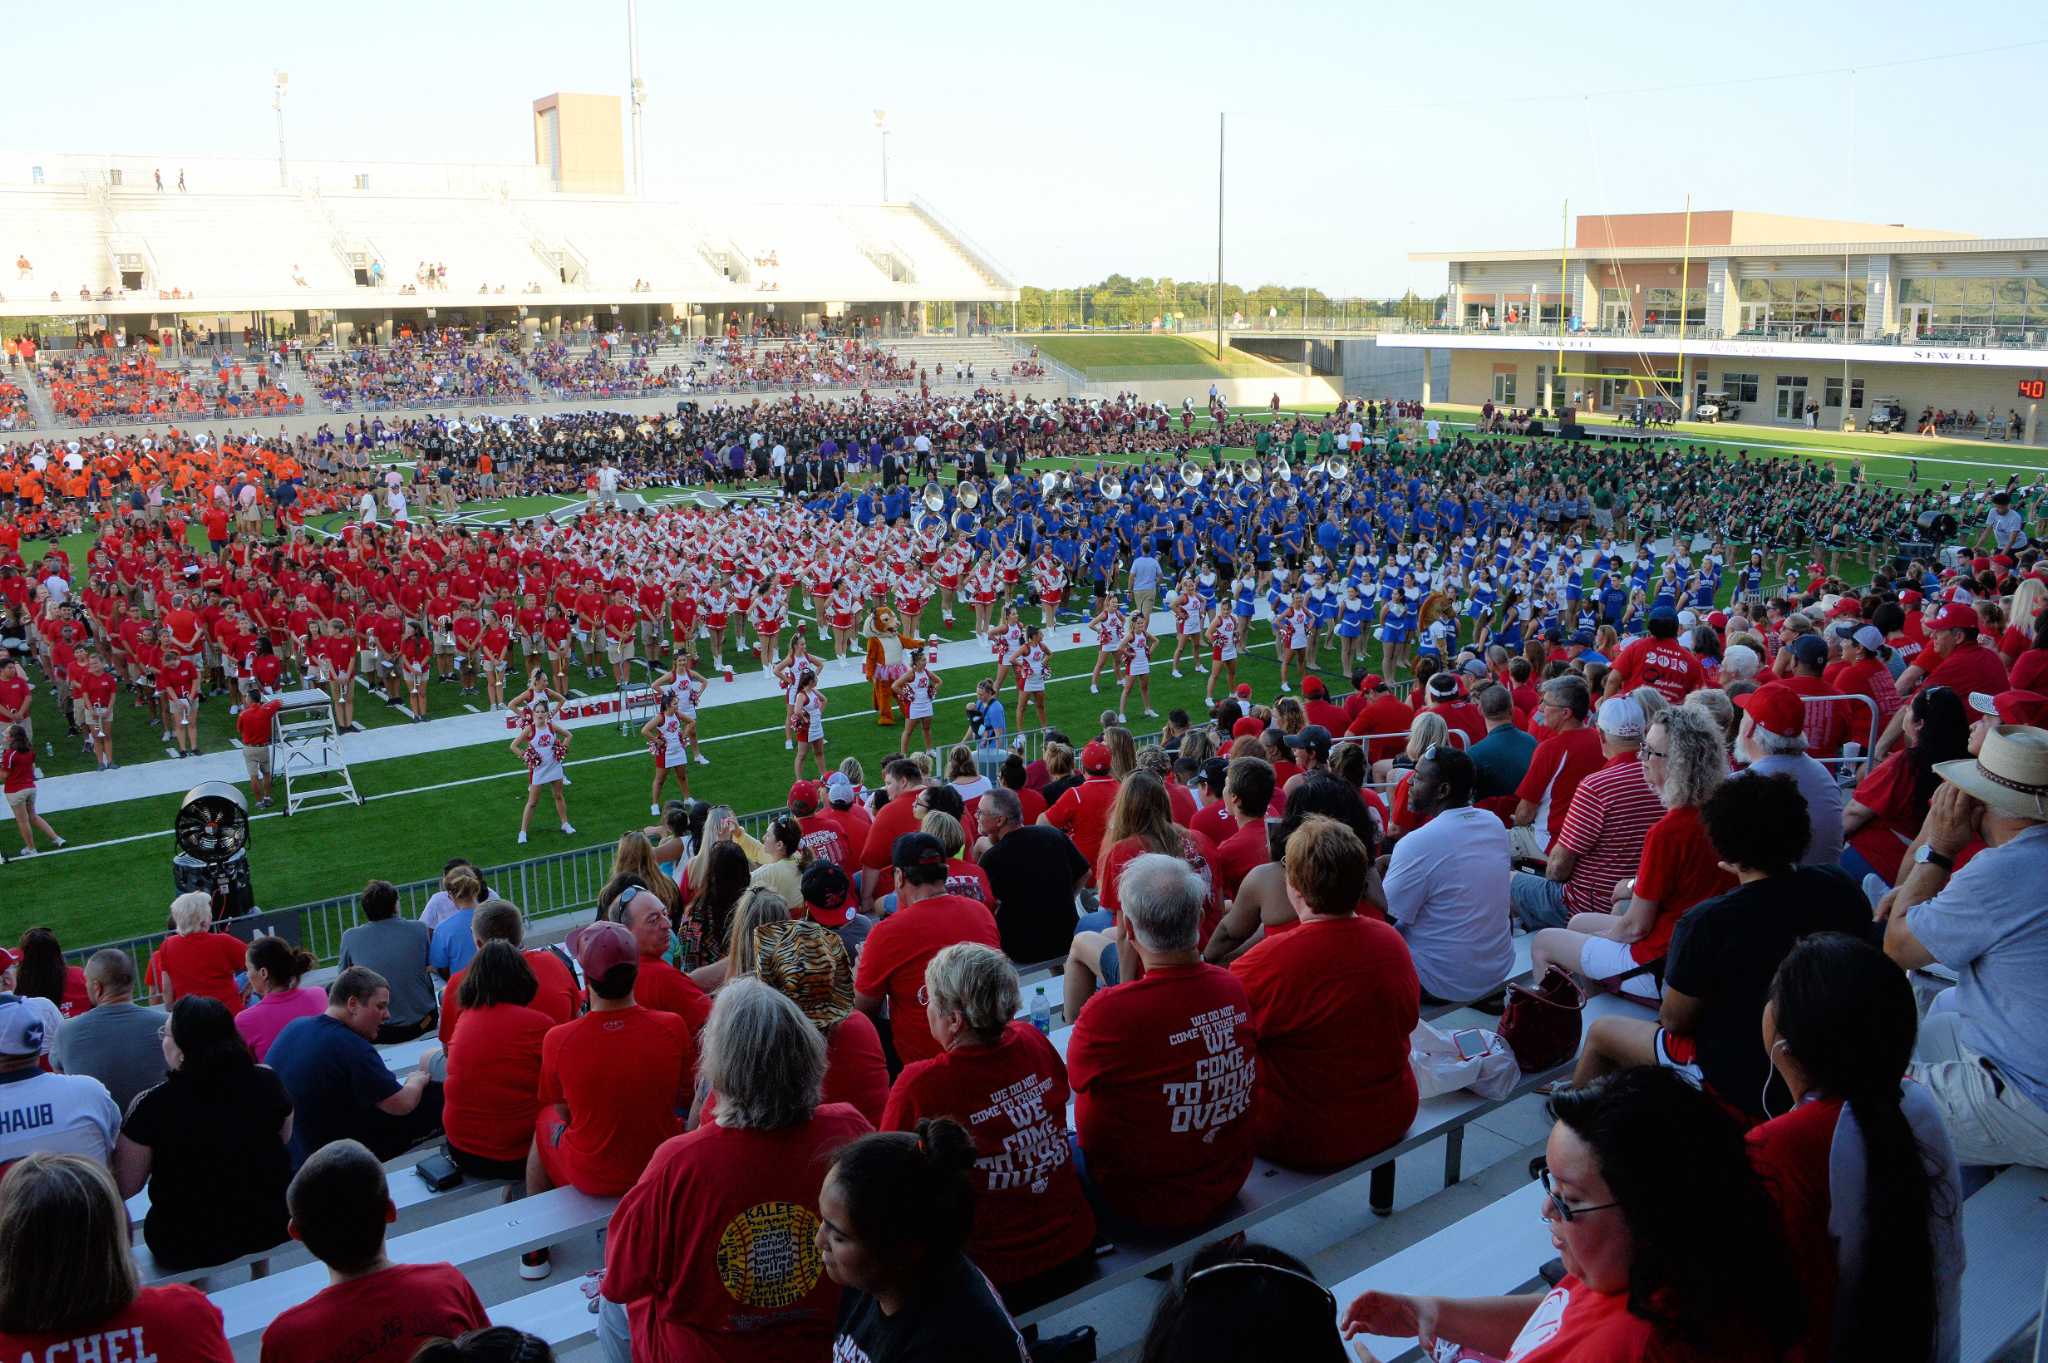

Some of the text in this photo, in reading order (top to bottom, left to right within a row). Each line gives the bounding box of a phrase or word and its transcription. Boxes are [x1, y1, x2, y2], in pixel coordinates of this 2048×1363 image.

[1913, 351, 1990, 361] SEWELL
[2020, 381, 2043, 398] 40
[1191, 1004, 1235, 1027] WE DO NOT
[1168, 1028, 1199, 1046] COME
[1200, 1021, 1213, 1036] TO
[1203, 1027, 1236, 1055] WE
[1196, 1046, 1244, 1081] COME
[989, 1088, 1009, 1104] WE
[1162, 1081, 1202, 1106] TO
[0, 1103, 54, 1136] HAUB
[969, 1105, 1001, 1125] COME
[1000, 1099, 1015, 1113] TO
[1005, 1096, 1048, 1129] WE
[745, 1202, 795, 1218] KALEE
